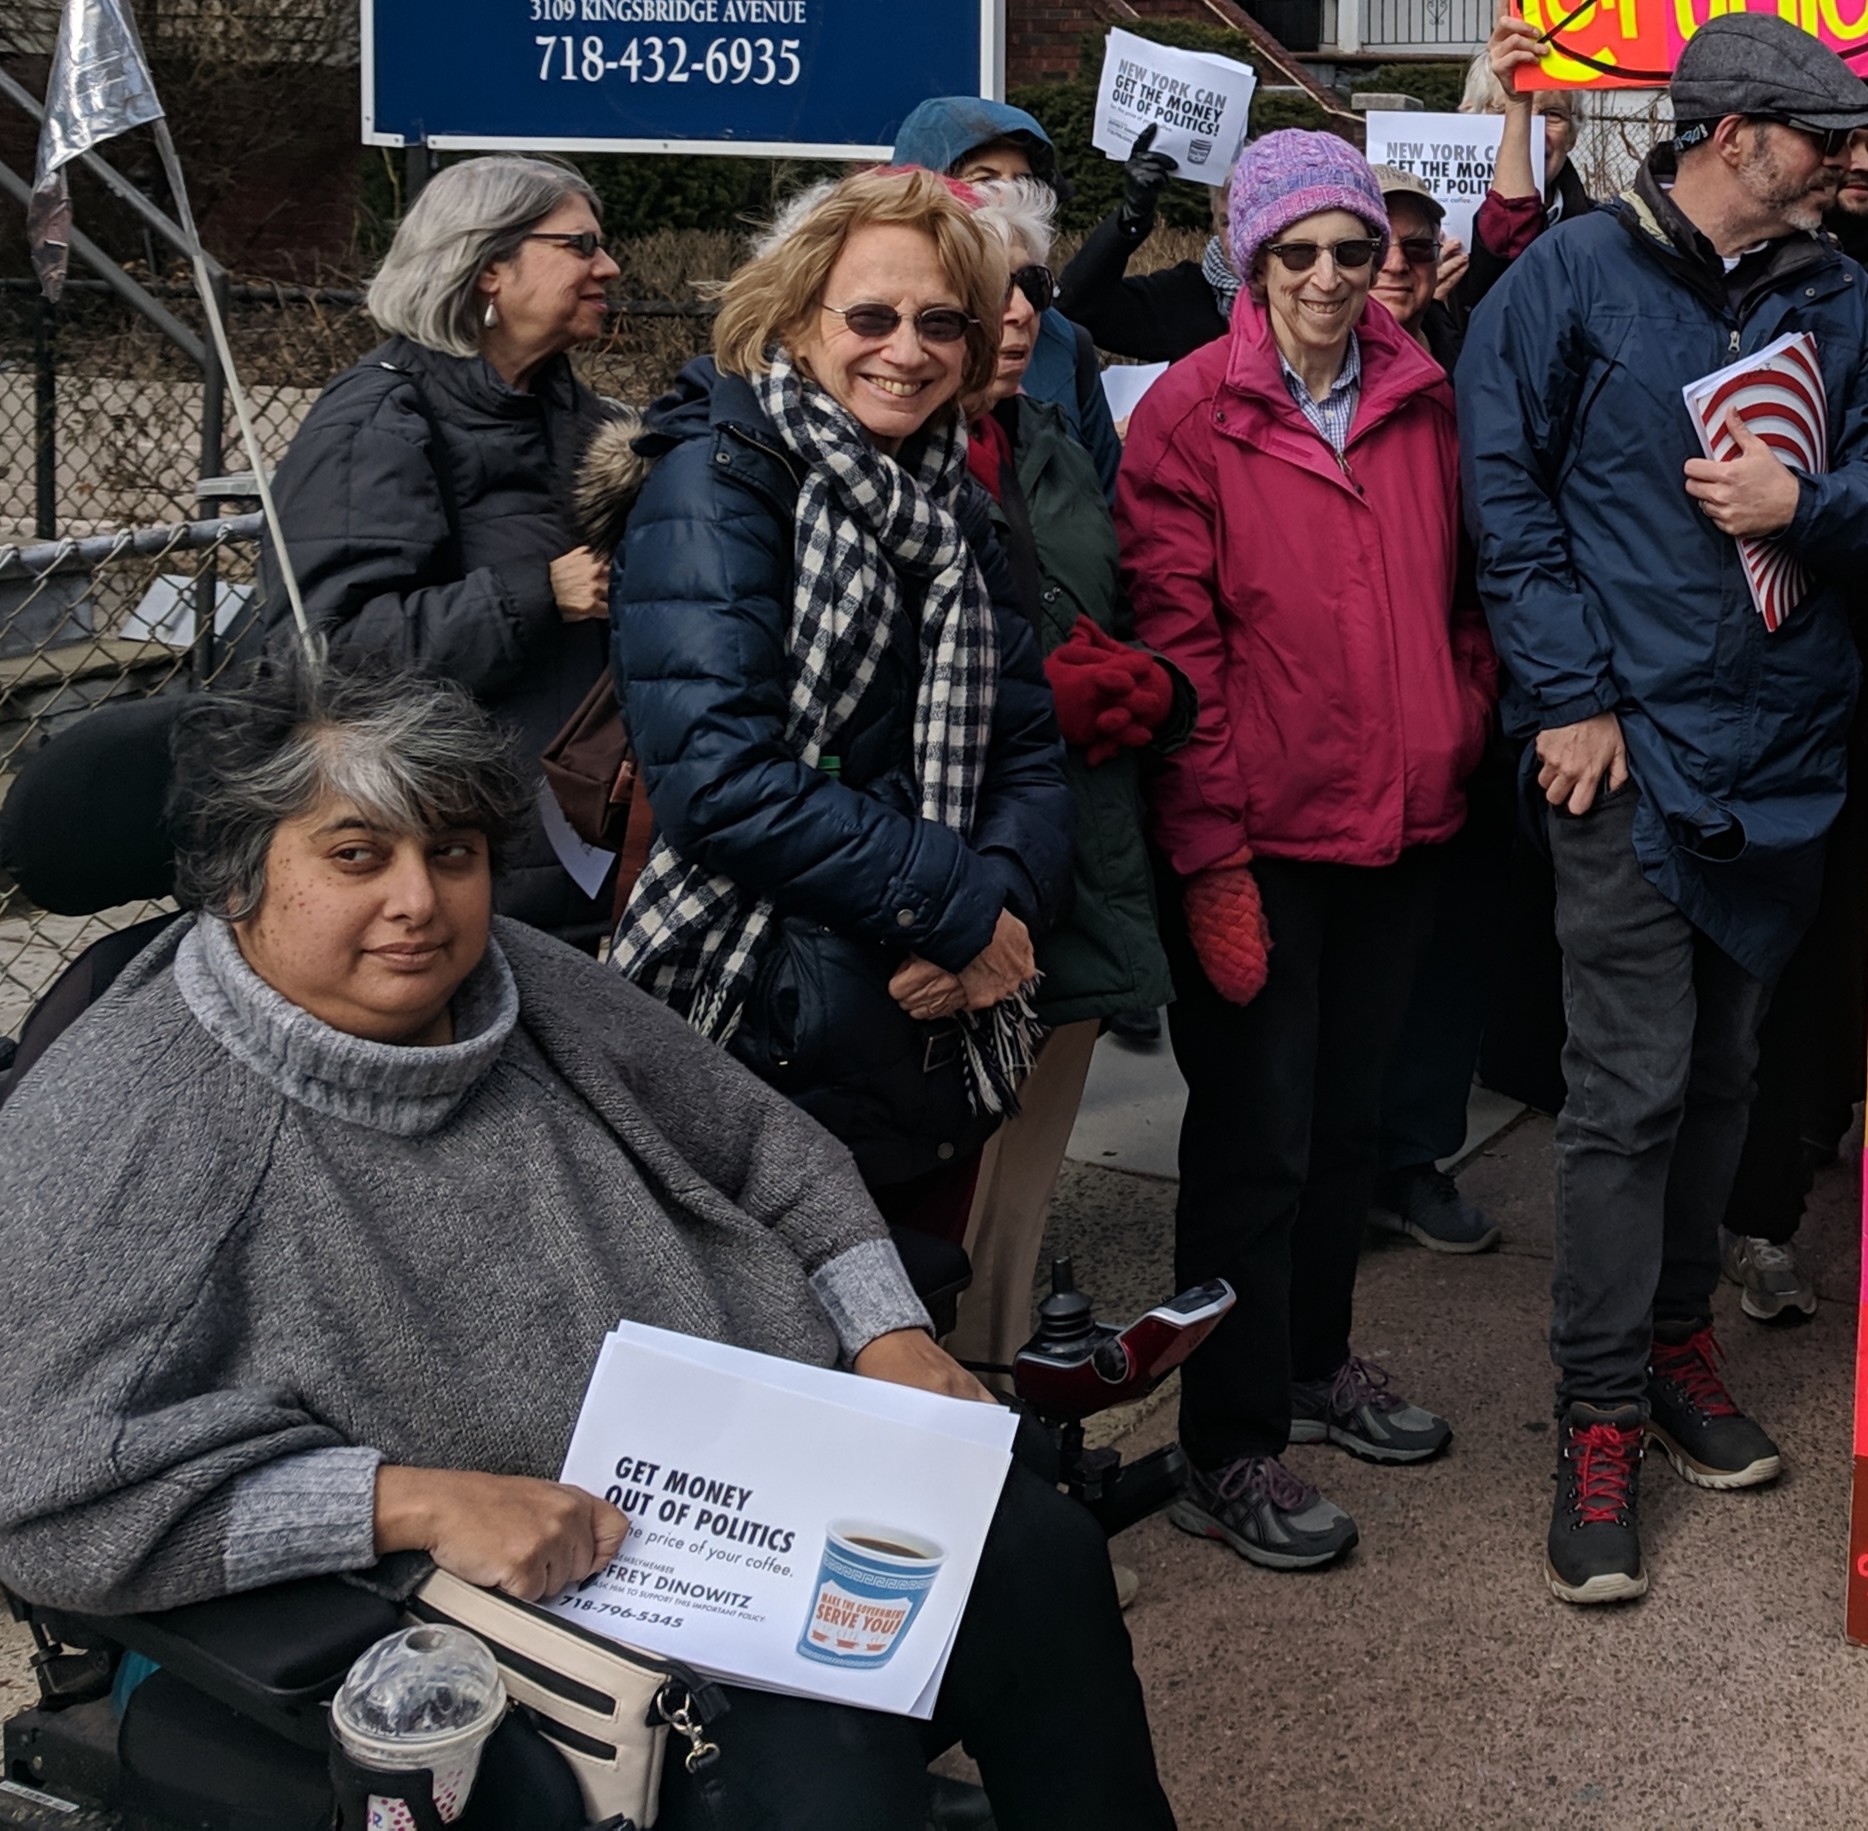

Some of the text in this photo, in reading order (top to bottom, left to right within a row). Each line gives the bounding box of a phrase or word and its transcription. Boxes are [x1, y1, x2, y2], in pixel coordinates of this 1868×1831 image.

[530, 0, 807, 23] 3109 KINGSBRIDGE AVENUE
[535, 35, 801, 85] 718-432-6935
[1115, 74, 1223, 123] GET THE MONEY
[1118, 59, 1227, 109] NEW YORK CAN
[1112, 89, 1135, 108] OUT
[1136, 100, 1152, 116] OF
[1154, 107, 1220, 137] POLITICS!
[1386, 142, 1424, 160] NEW
[1430, 144, 1478, 162] YORK
[1420, 161, 1449, 178] THE
[1456, 162, 1495, 179] MON
[1446, 179, 1491, 195] POLIT
[615, 1457, 753, 1511] GET MONEY
[605, 1485, 795, 1553] OUT OF POLITICS
[628, 1521, 793, 1578] he price of your coffee.
[605, 1563, 752, 1609] FREY DINOWITZ
[639, 1590, 673, 1604] SUPPORT
[691, 1602, 737, 1616] IMPORTANT
[559, 1595, 684, 1628] 718-796-5345
[816, 1604, 902, 1635] SERVE YOU!
[821, 1592, 906, 1620] MAKE THE GOVERNMENT
